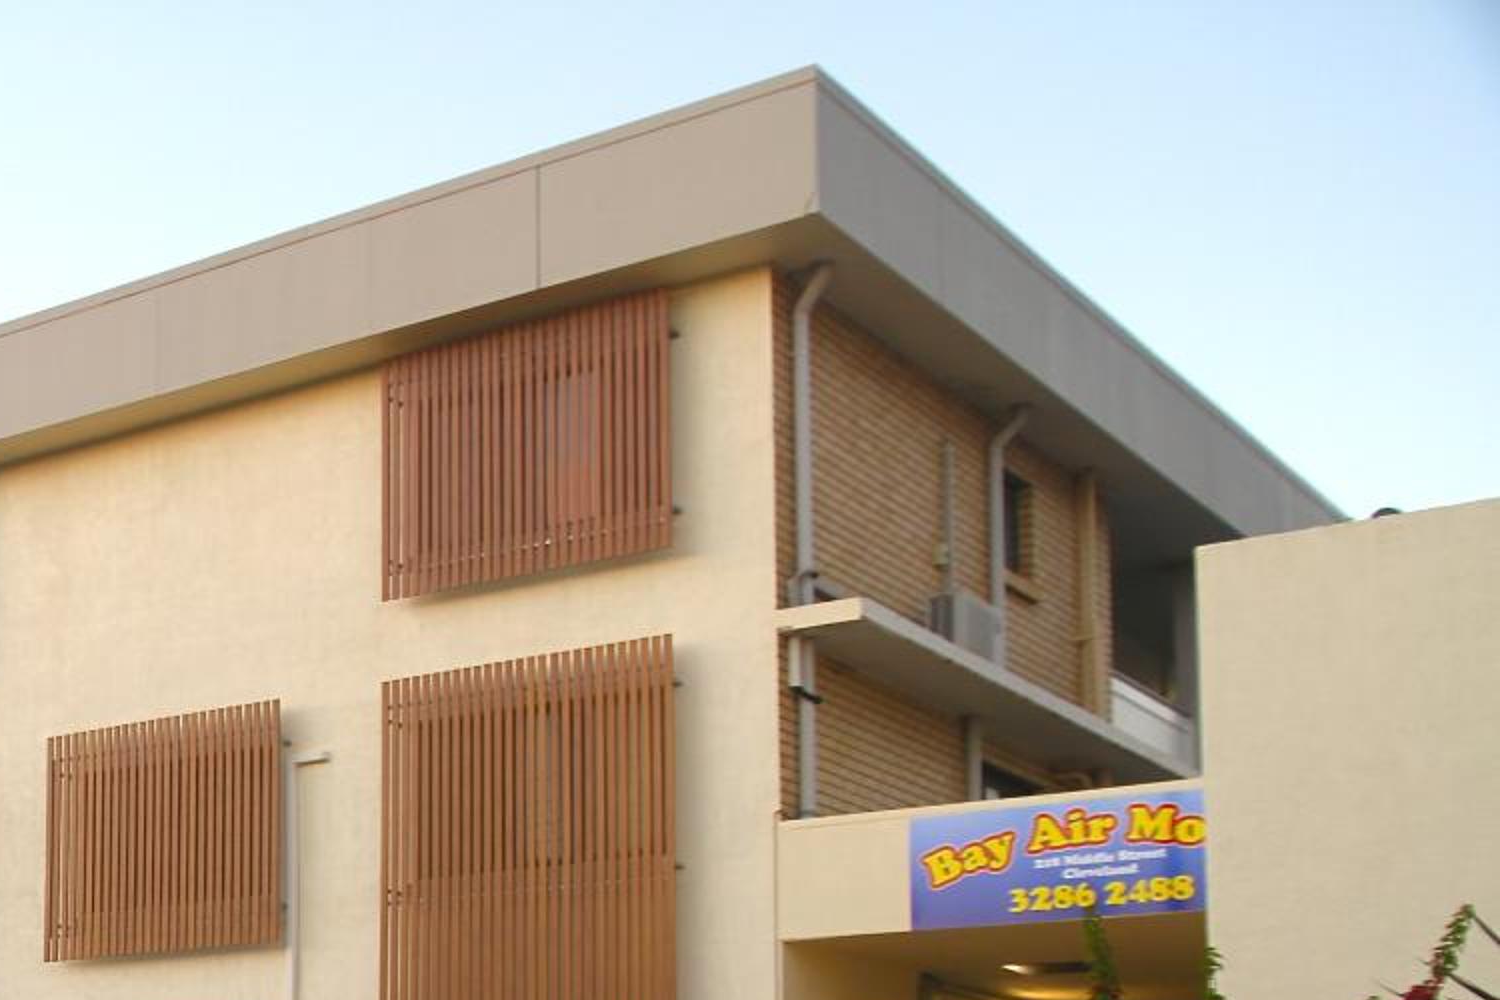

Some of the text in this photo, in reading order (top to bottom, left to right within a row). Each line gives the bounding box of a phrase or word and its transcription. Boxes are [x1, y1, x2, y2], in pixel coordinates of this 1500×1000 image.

[922, 804, 1206, 888] Bay Air Mo
[1008, 875, 1195, 913] 3286 2488
